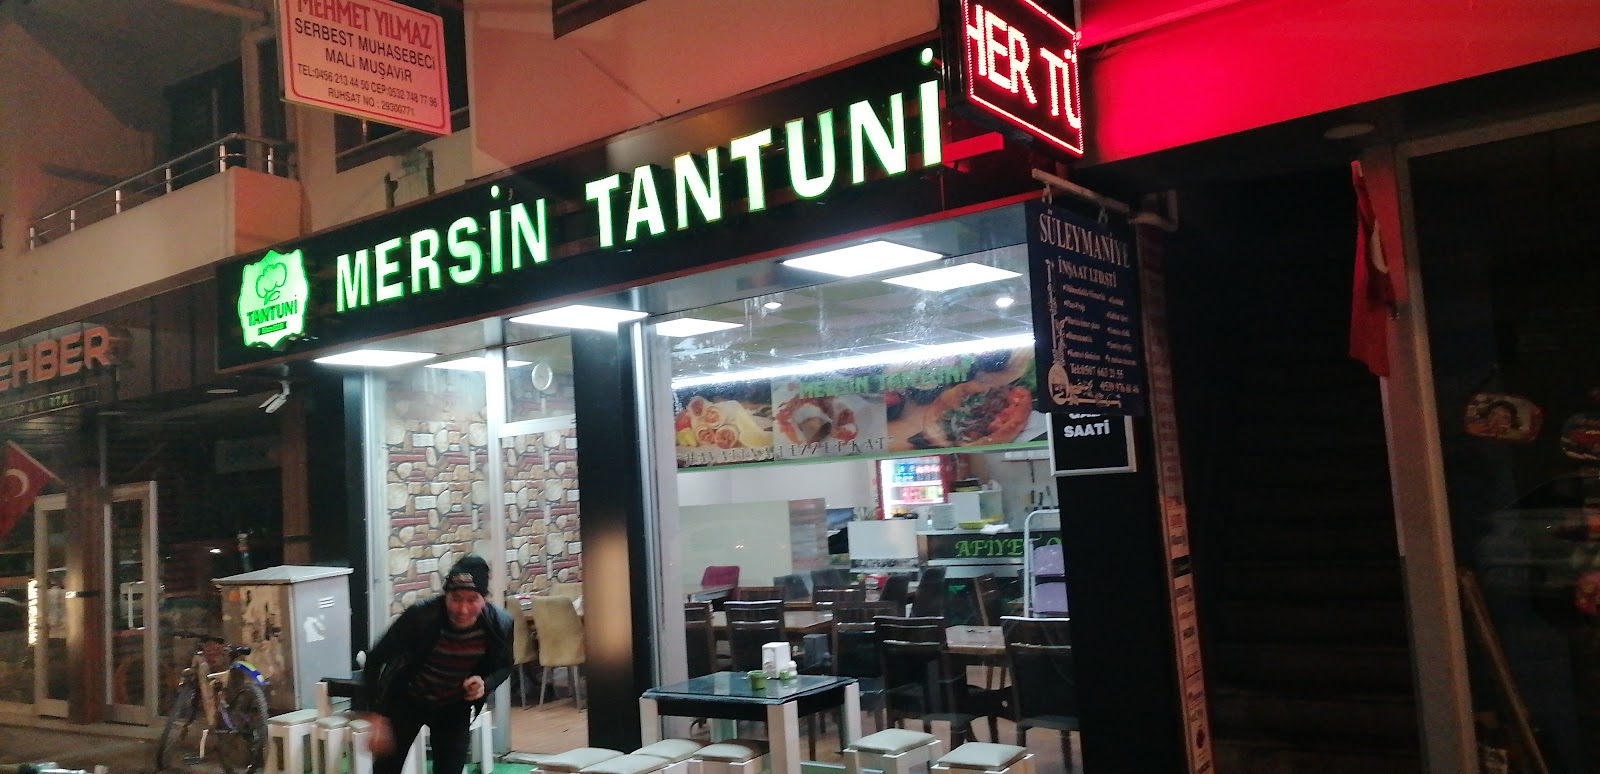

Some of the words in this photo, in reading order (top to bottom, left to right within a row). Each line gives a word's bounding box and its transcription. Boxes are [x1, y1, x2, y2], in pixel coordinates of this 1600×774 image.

[294, 17, 354, 47] SERBEST
[298, 0, 370, 31] MEHMET
[374, 8, 432, 49] YILMAZ
[335, 73, 348, 86] 213
[327, 87, 361, 104] RUHSAT
[362, 96, 375, 107] NO
[336, 185, 548, 313] MERSİN
[586, 47, 942, 248] TANTUNİ
[1040, 208, 1130, 268] SÜLEYMANİYE
[1063, 419, 1110, 438] SAATİ
